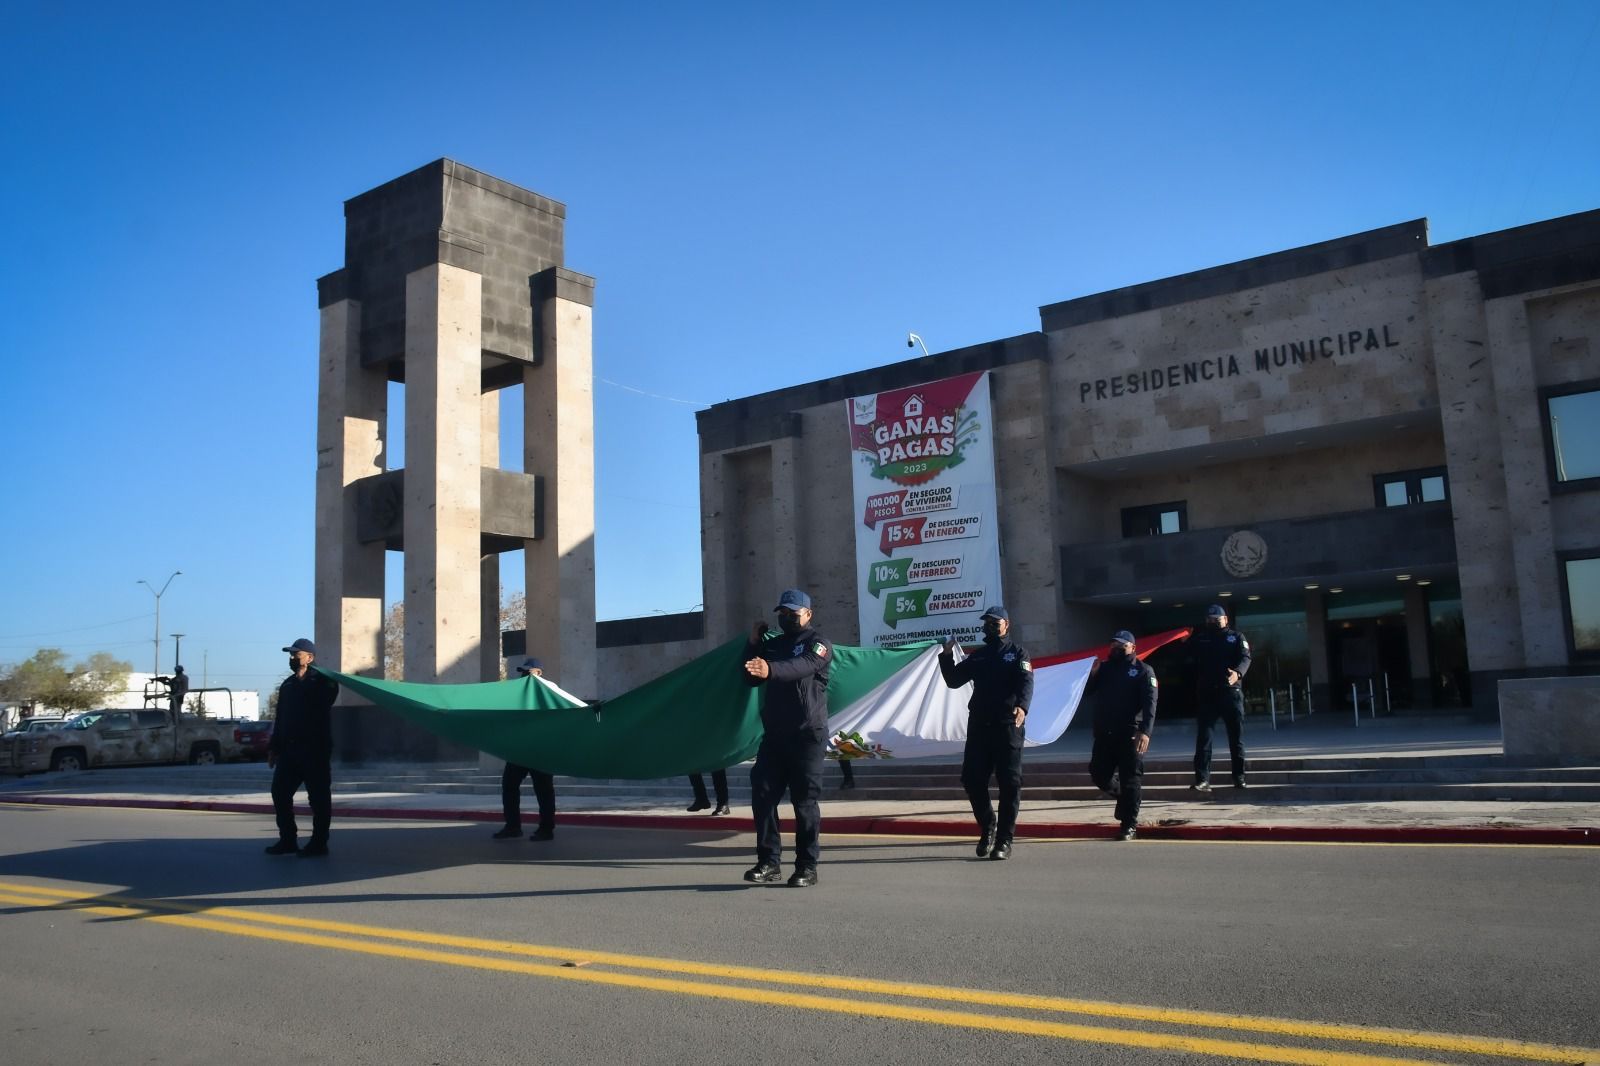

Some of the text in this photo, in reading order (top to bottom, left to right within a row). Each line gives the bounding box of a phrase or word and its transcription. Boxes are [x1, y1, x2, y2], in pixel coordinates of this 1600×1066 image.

[1079, 325, 1399, 403] PRESIDENCIA MUNICIPAL
[875, 415, 955, 445] GANAS
[877, 437, 955, 467] PAGAS
[903, 463, 927, 474] 2023
[909, 486, 952, 499] EN SEGURO
[905, 494, 952, 507] DE VIVIENDA
[874, 506, 896, 517] PESOS
[928, 516, 979, 529] DE DESCUENTO
[887, 525, 915, 542] 15%
[924, 525, 966, 538] EN ENERO
[922, 558, 961, 568] DESCUENTO
[875, 565, 900, 582] 10%
[909, 566, 957, 579] EN FEBRERO
[942, 590, 983, 600] DESCUENTO
[896, 597, 917, 613] 5%
[929, 599, 976, 611] EN MARZO
[880, 633, 906, 641] MUCHOS
[906, 630, 935, 639] PREMIOS
[936, 627, 951, 636] MÁS
[952, 626, 971, 635] PARA
